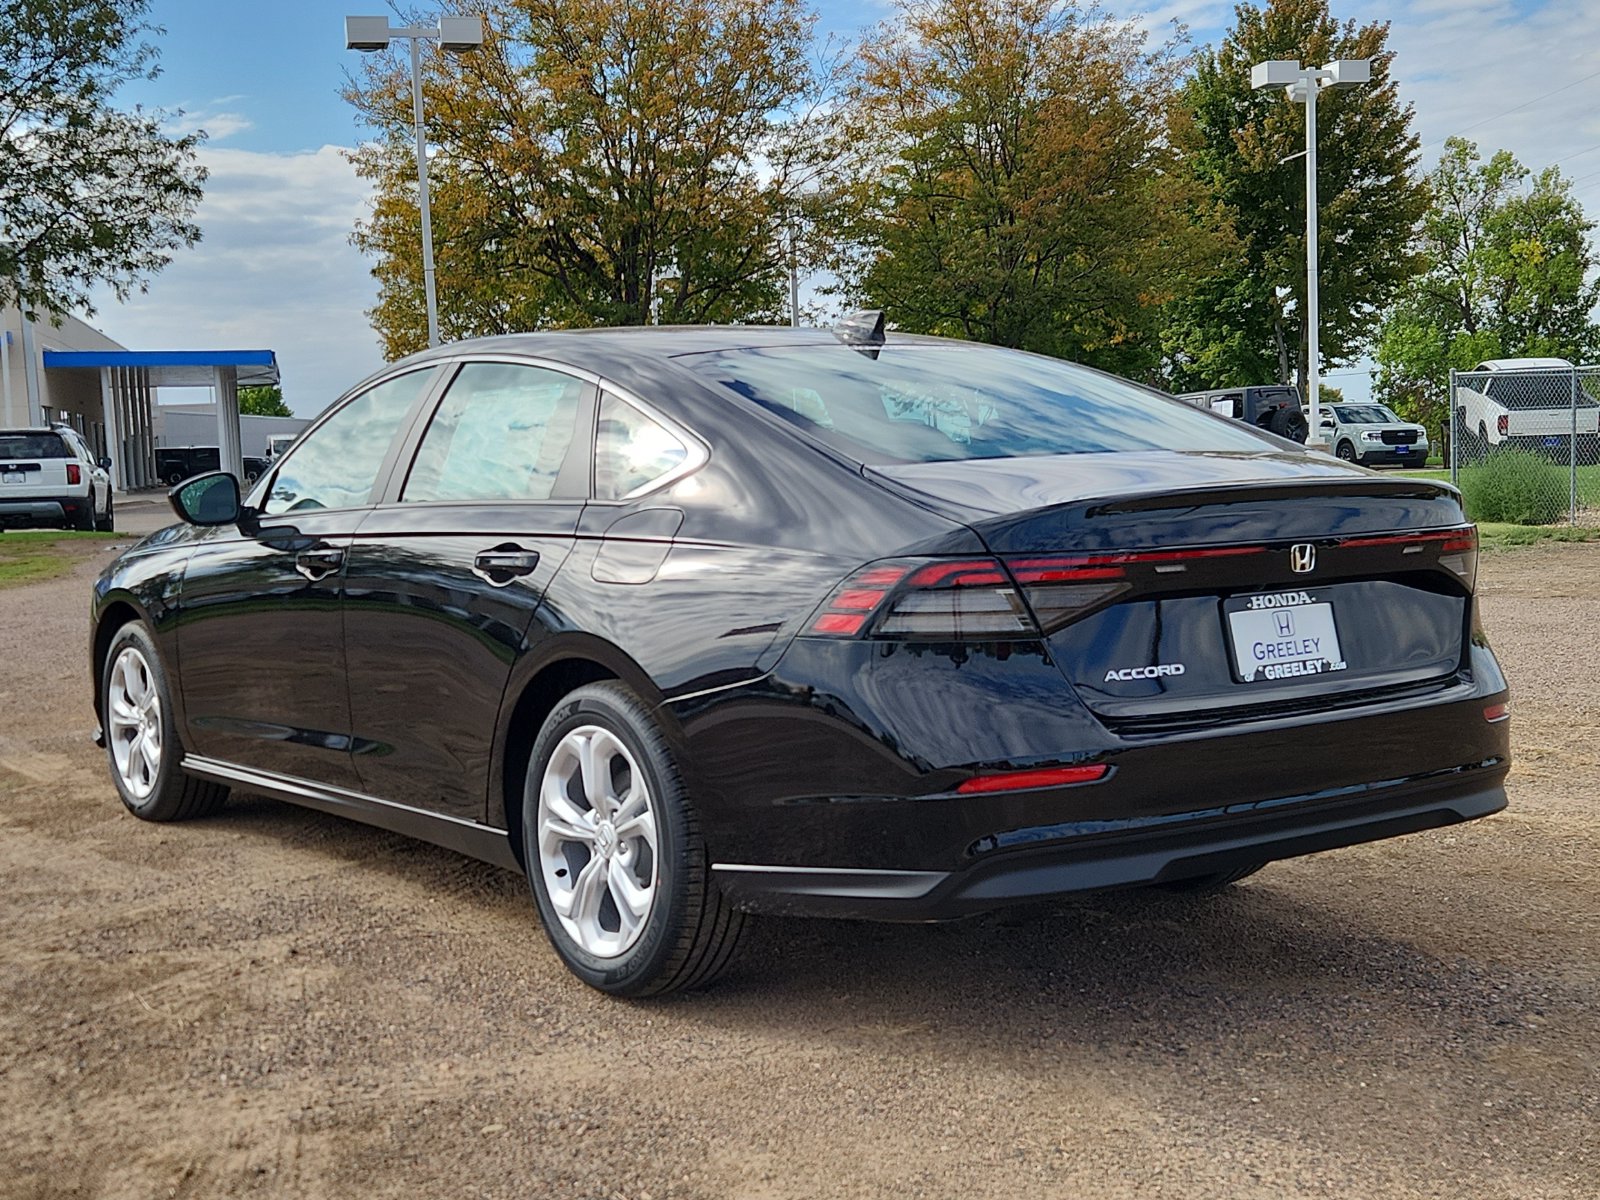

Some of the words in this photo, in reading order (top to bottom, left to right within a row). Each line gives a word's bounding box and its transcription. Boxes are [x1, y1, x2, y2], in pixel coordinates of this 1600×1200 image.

[1251, 592, 1312, 609] HONDA
[1253, 637, 1321, 661] GREELEY
[1104, 663, 1185, 682] ACCORD
[1265, 660, 1322, 680] GREELEY
